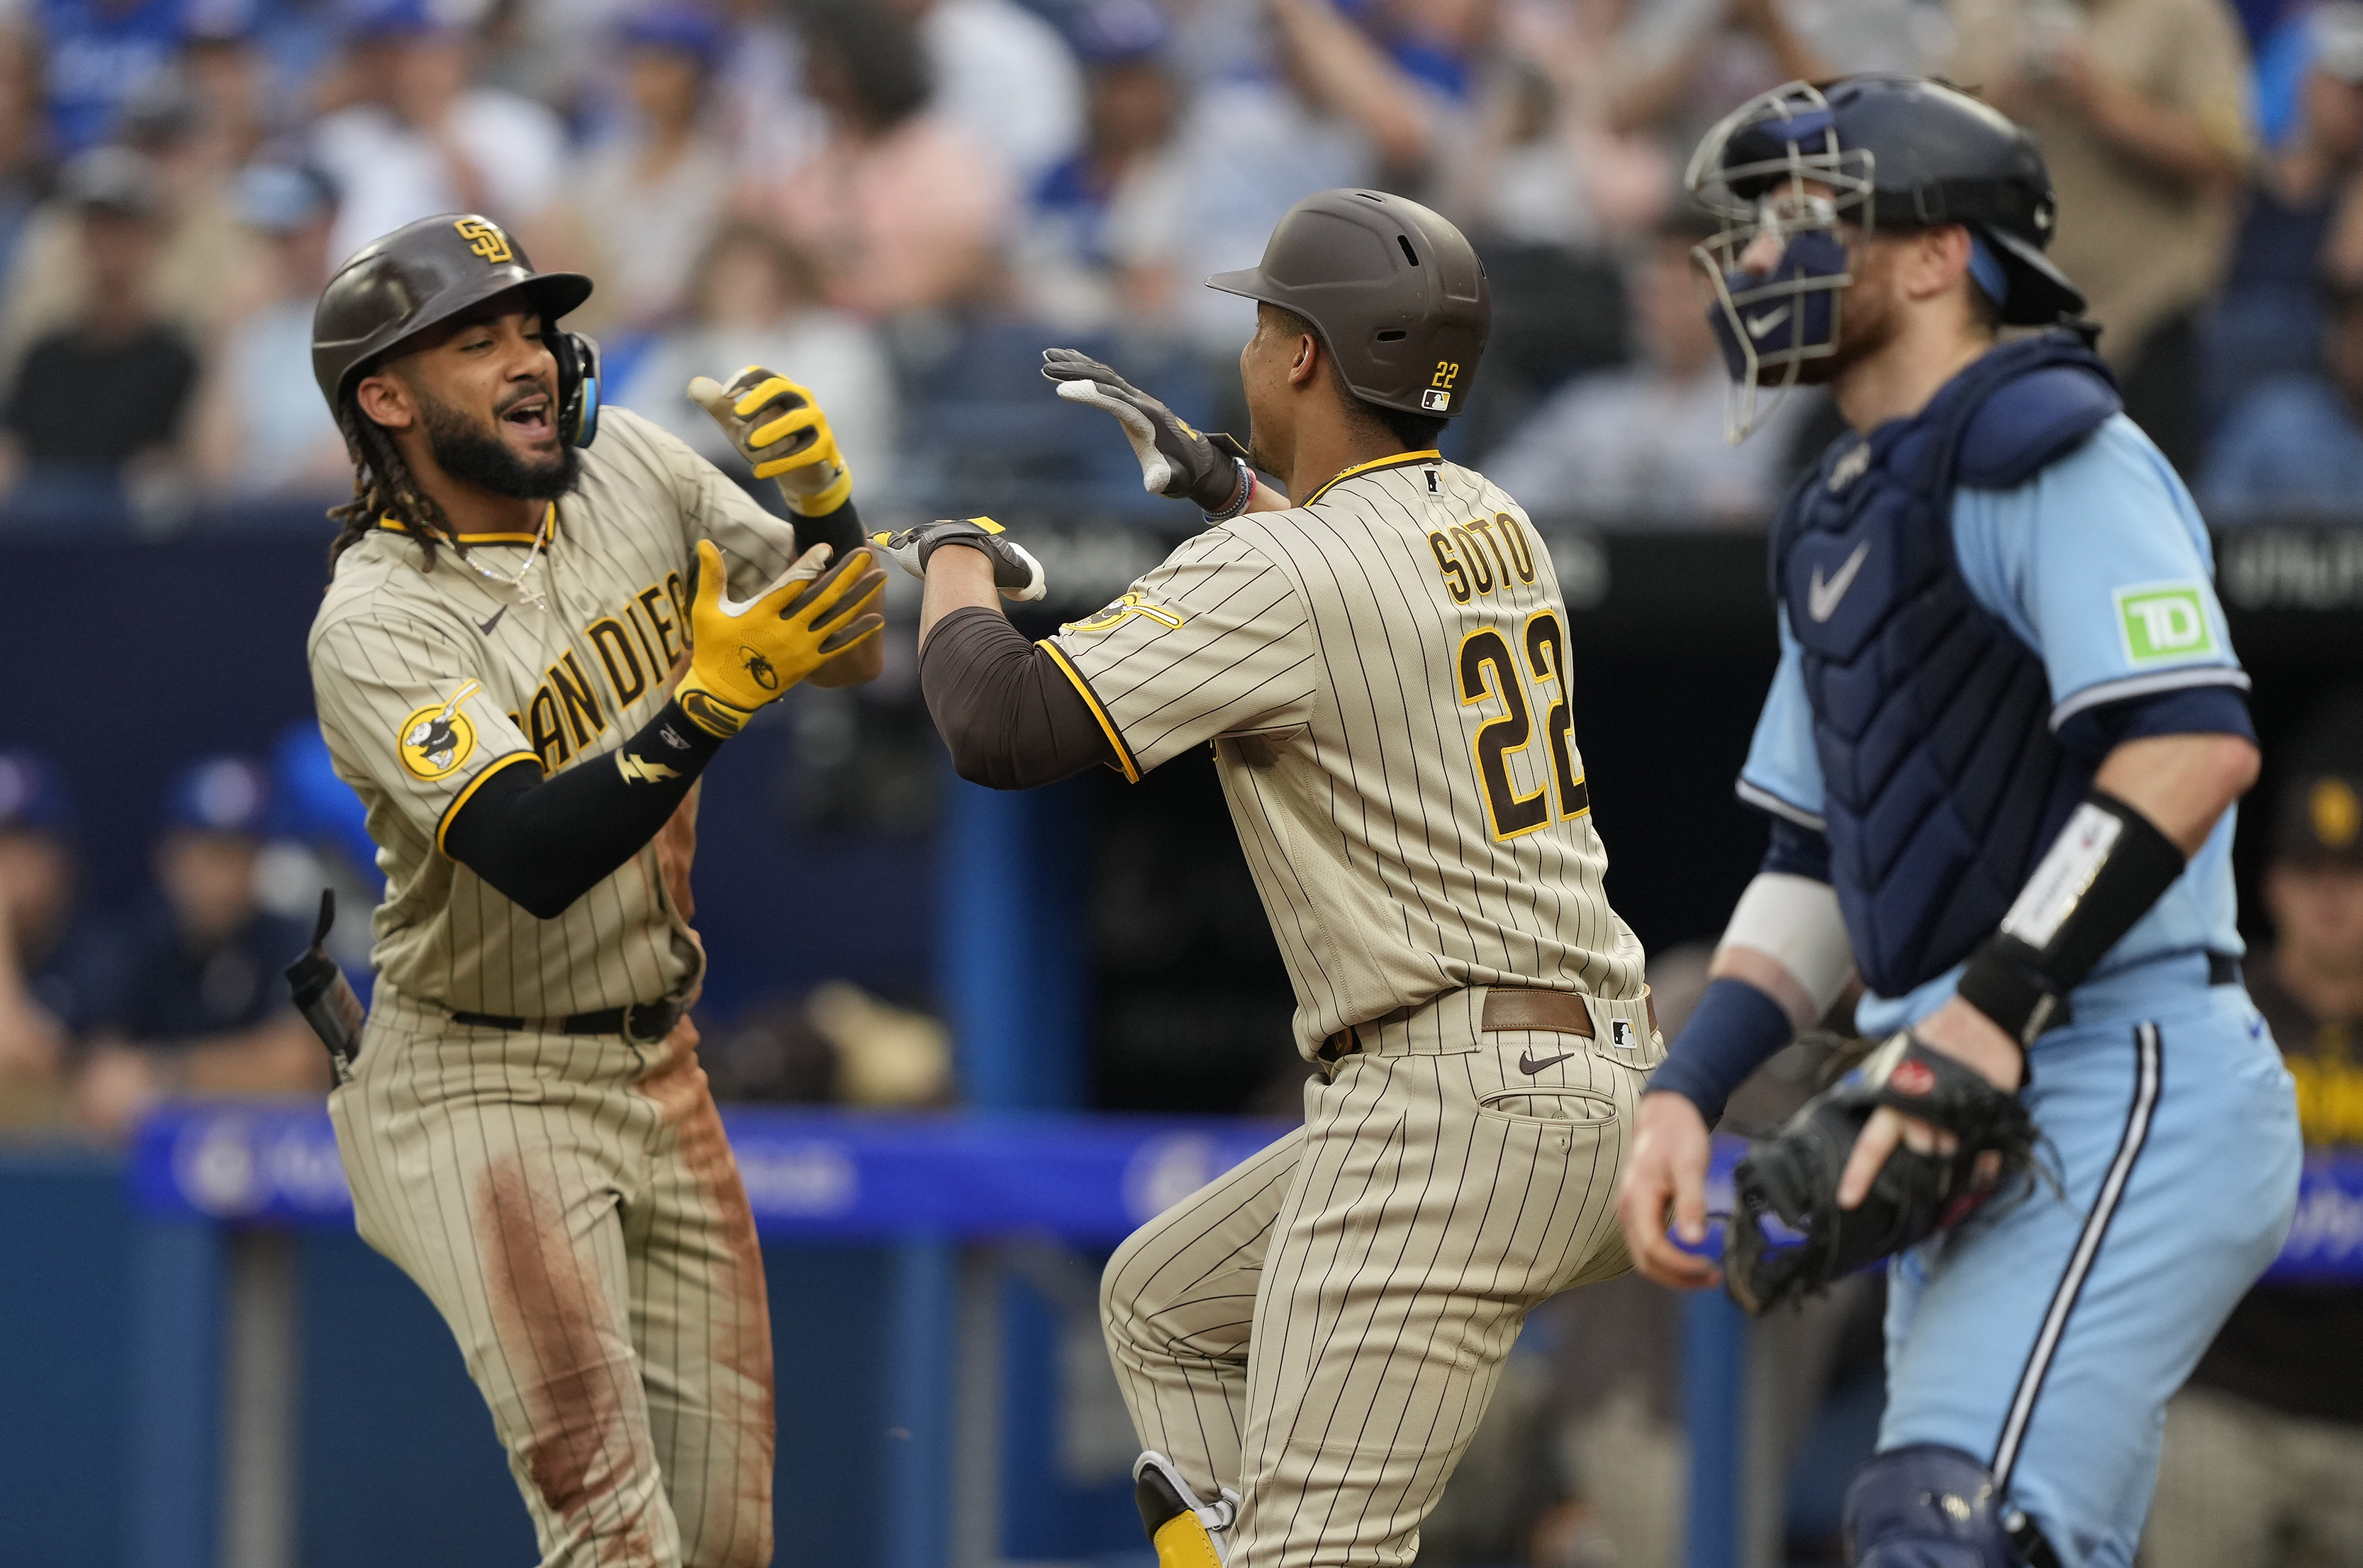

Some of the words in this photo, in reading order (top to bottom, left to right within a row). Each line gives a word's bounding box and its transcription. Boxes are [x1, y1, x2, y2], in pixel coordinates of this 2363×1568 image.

[454, 219, 513, 264] SD
[1431, 361, 1460, 389] 22
[1427, 511, 1536, 605] SOTO
[2128, 596, 2202, 651] TD
[507, 646, 608, 780] AN
[585, 570, 695, 710] DIEG
[1456, 607, 1590, 843] 22
